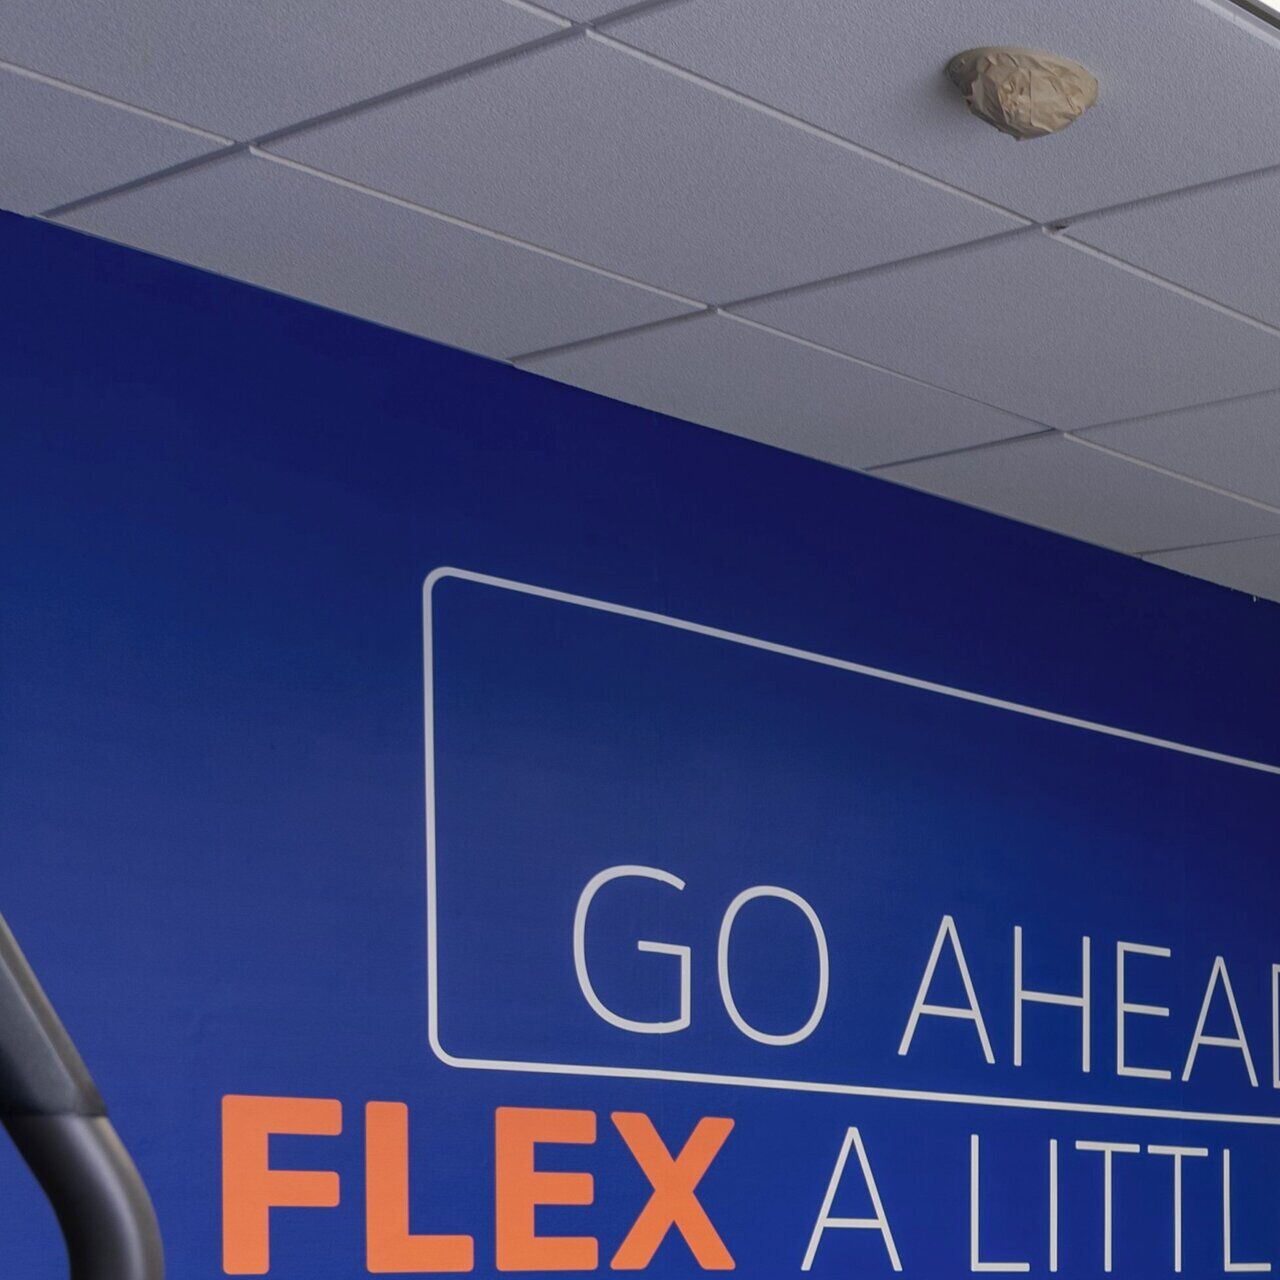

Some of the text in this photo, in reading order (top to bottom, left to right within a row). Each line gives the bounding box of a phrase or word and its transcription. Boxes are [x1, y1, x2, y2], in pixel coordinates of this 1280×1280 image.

[573, 865, 830, 1047] GO
[221, 1094, 736, 1276] FLEX
[802, 1126, 903, 1272] A
